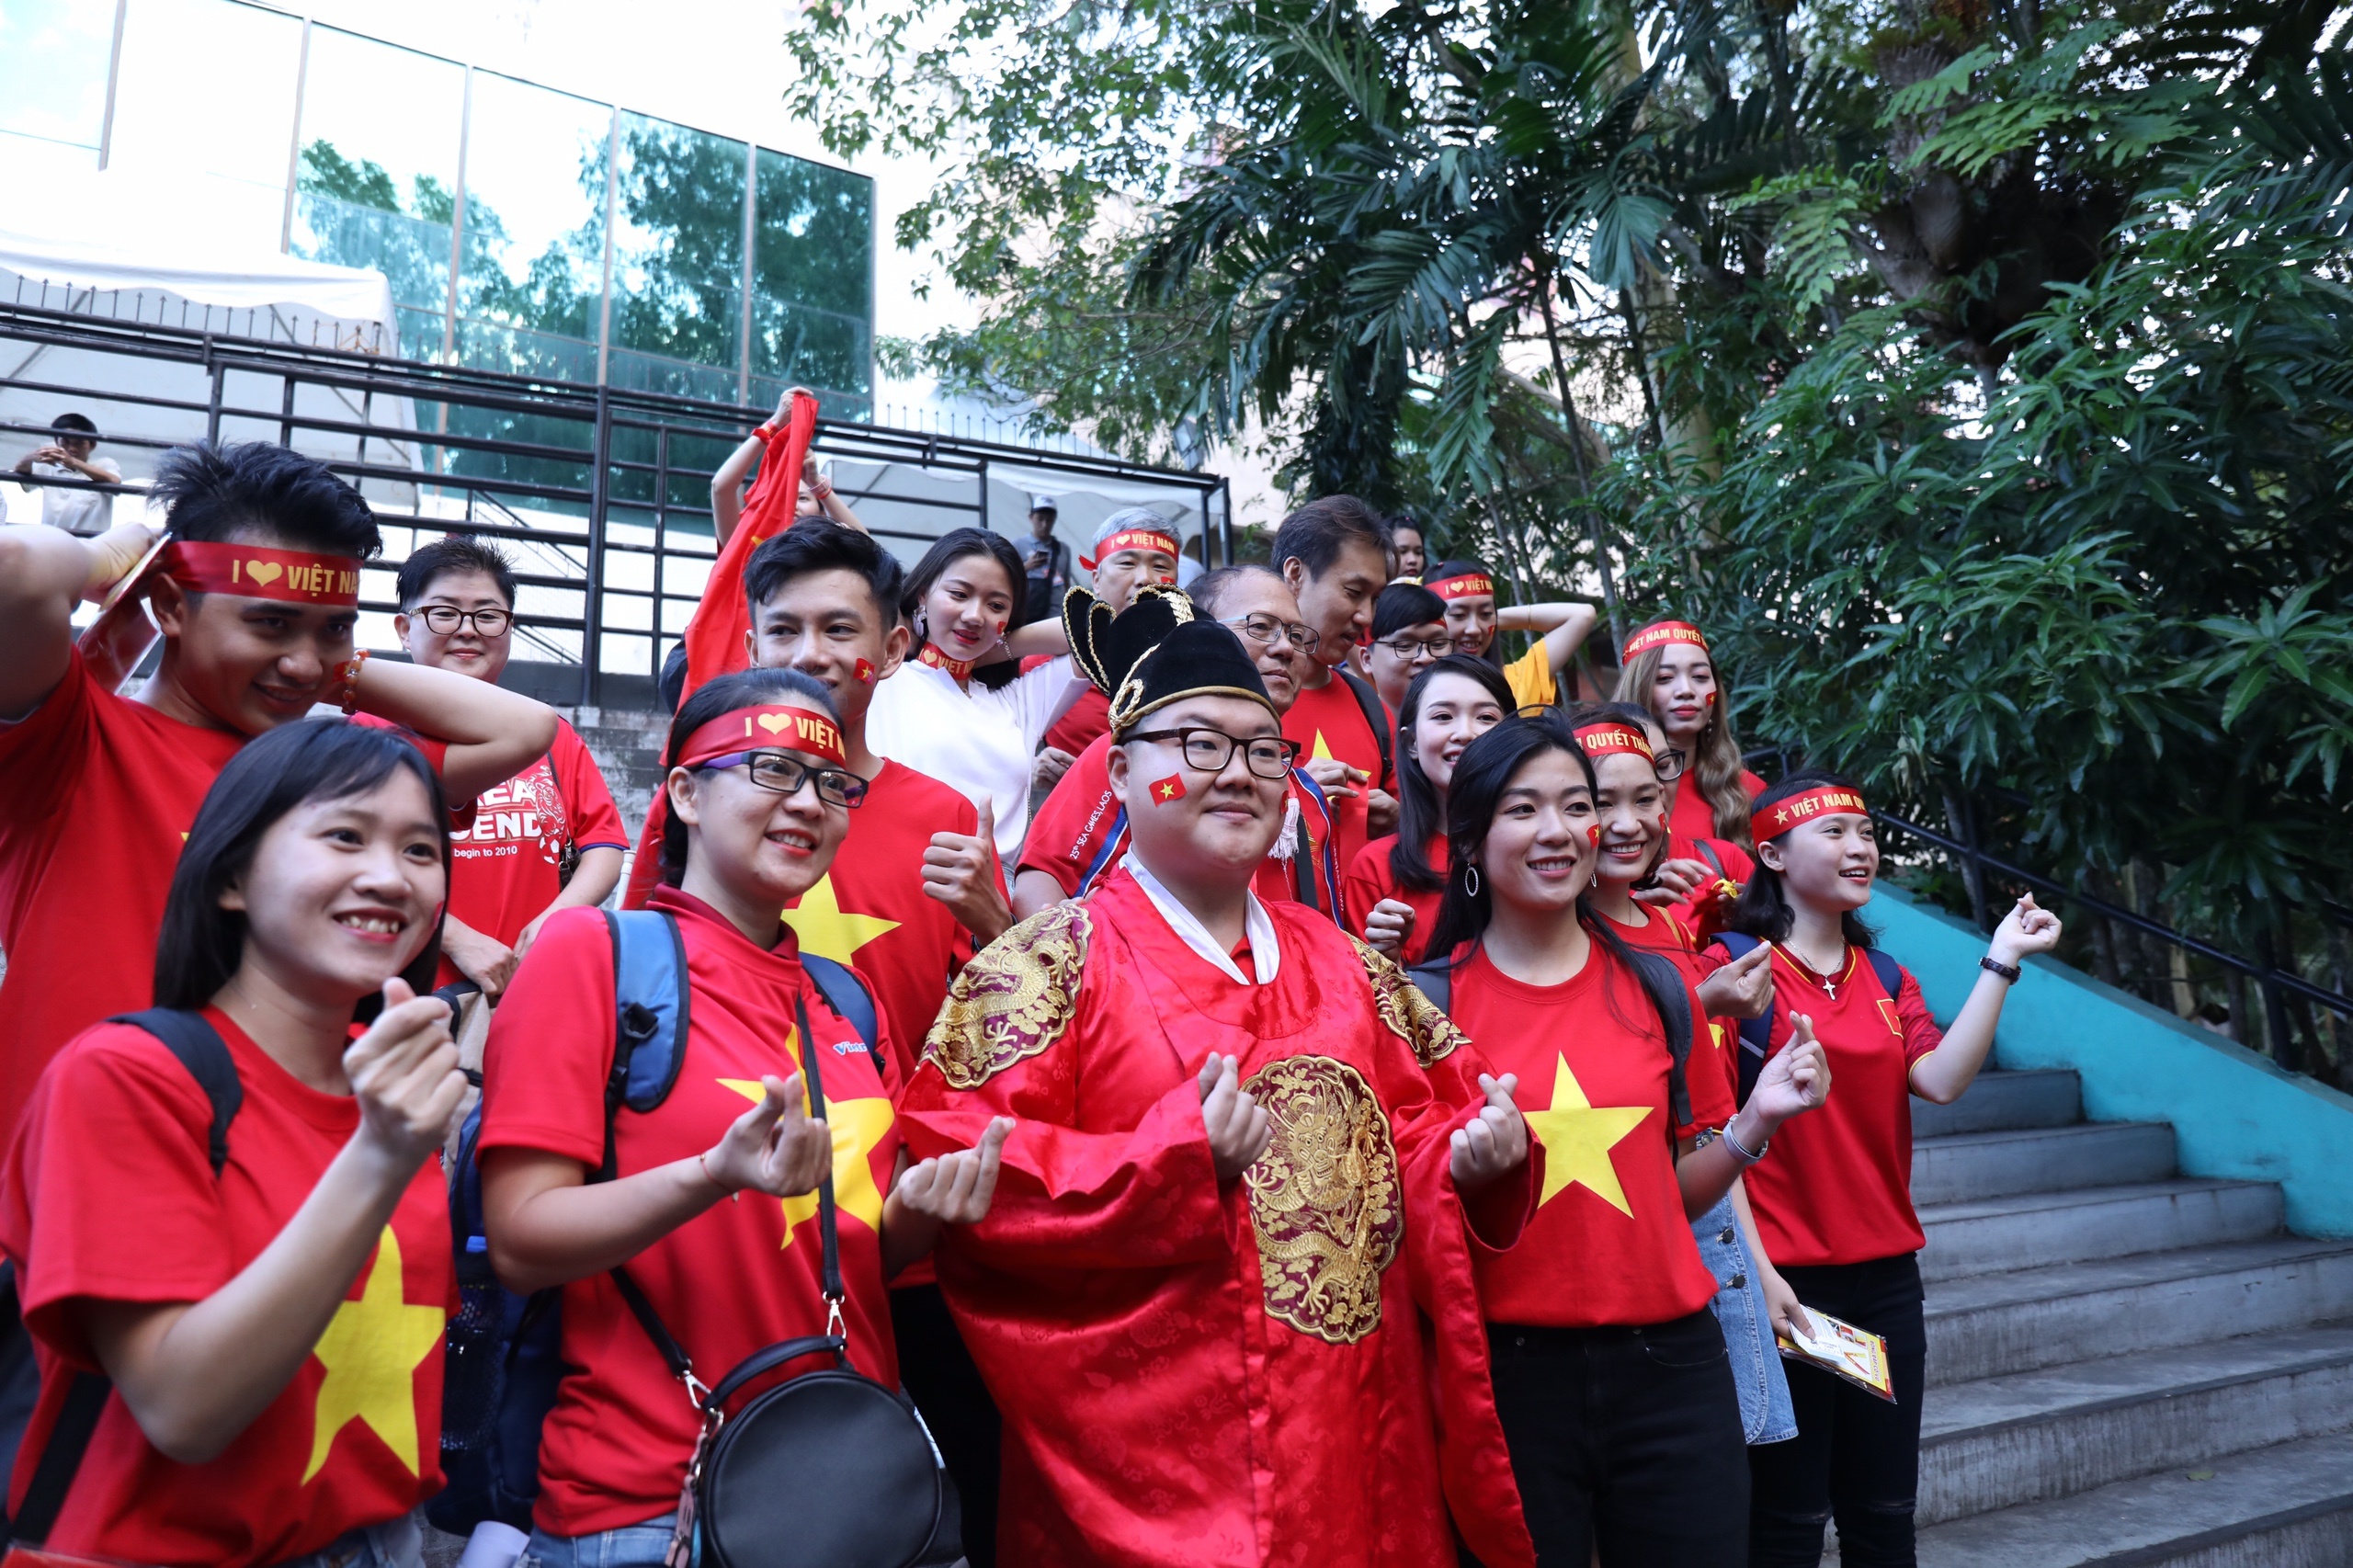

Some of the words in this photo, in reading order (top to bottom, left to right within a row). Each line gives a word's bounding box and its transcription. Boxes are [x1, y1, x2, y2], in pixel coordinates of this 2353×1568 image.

[1131, 533, 1154, 547] VIỆT
[1156, 537, 1176, 554] NAM
[287, 563, 335, 597] VIỆT
[338, 570, 359, 594] NA
[1645, 629, 1670, 642] NAM
[795, 716, 835, 749] VIỆT
[1586, 729, 1629, 750] QUYẾT
[1790, 797, 1820, 818] VIỆT
[1822, 793, 1853, 808] NAM
[1076, 833, 1090, 846] SEA
[453, 848, 481, 859] begin
[483, 846, 494, 858] to
[494, 846, 518, 857] 2010
